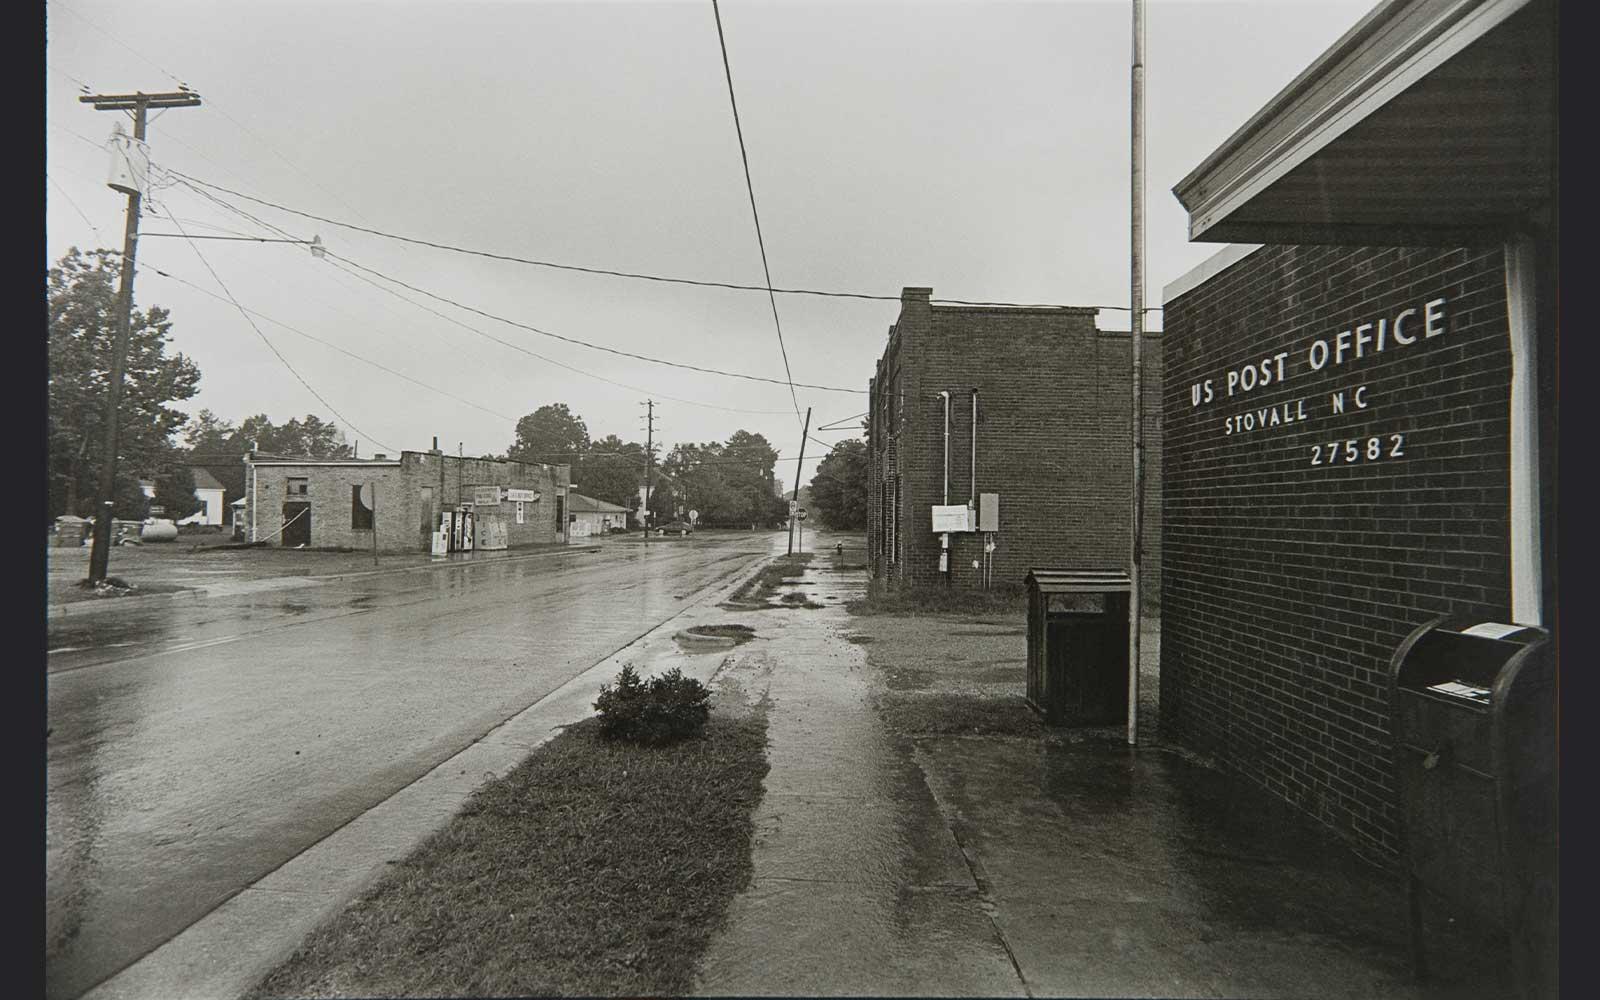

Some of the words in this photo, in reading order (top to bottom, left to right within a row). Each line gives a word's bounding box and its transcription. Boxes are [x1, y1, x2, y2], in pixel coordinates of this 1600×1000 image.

[1191, 379, 1214, 407] US
[1227, 352, 1288, 397] POST
[1309, 298, 1446, 370] OFFICE
[1225, 400, 1307, 435] STOVALL
[1311, 434, 1404, 466] 27582
